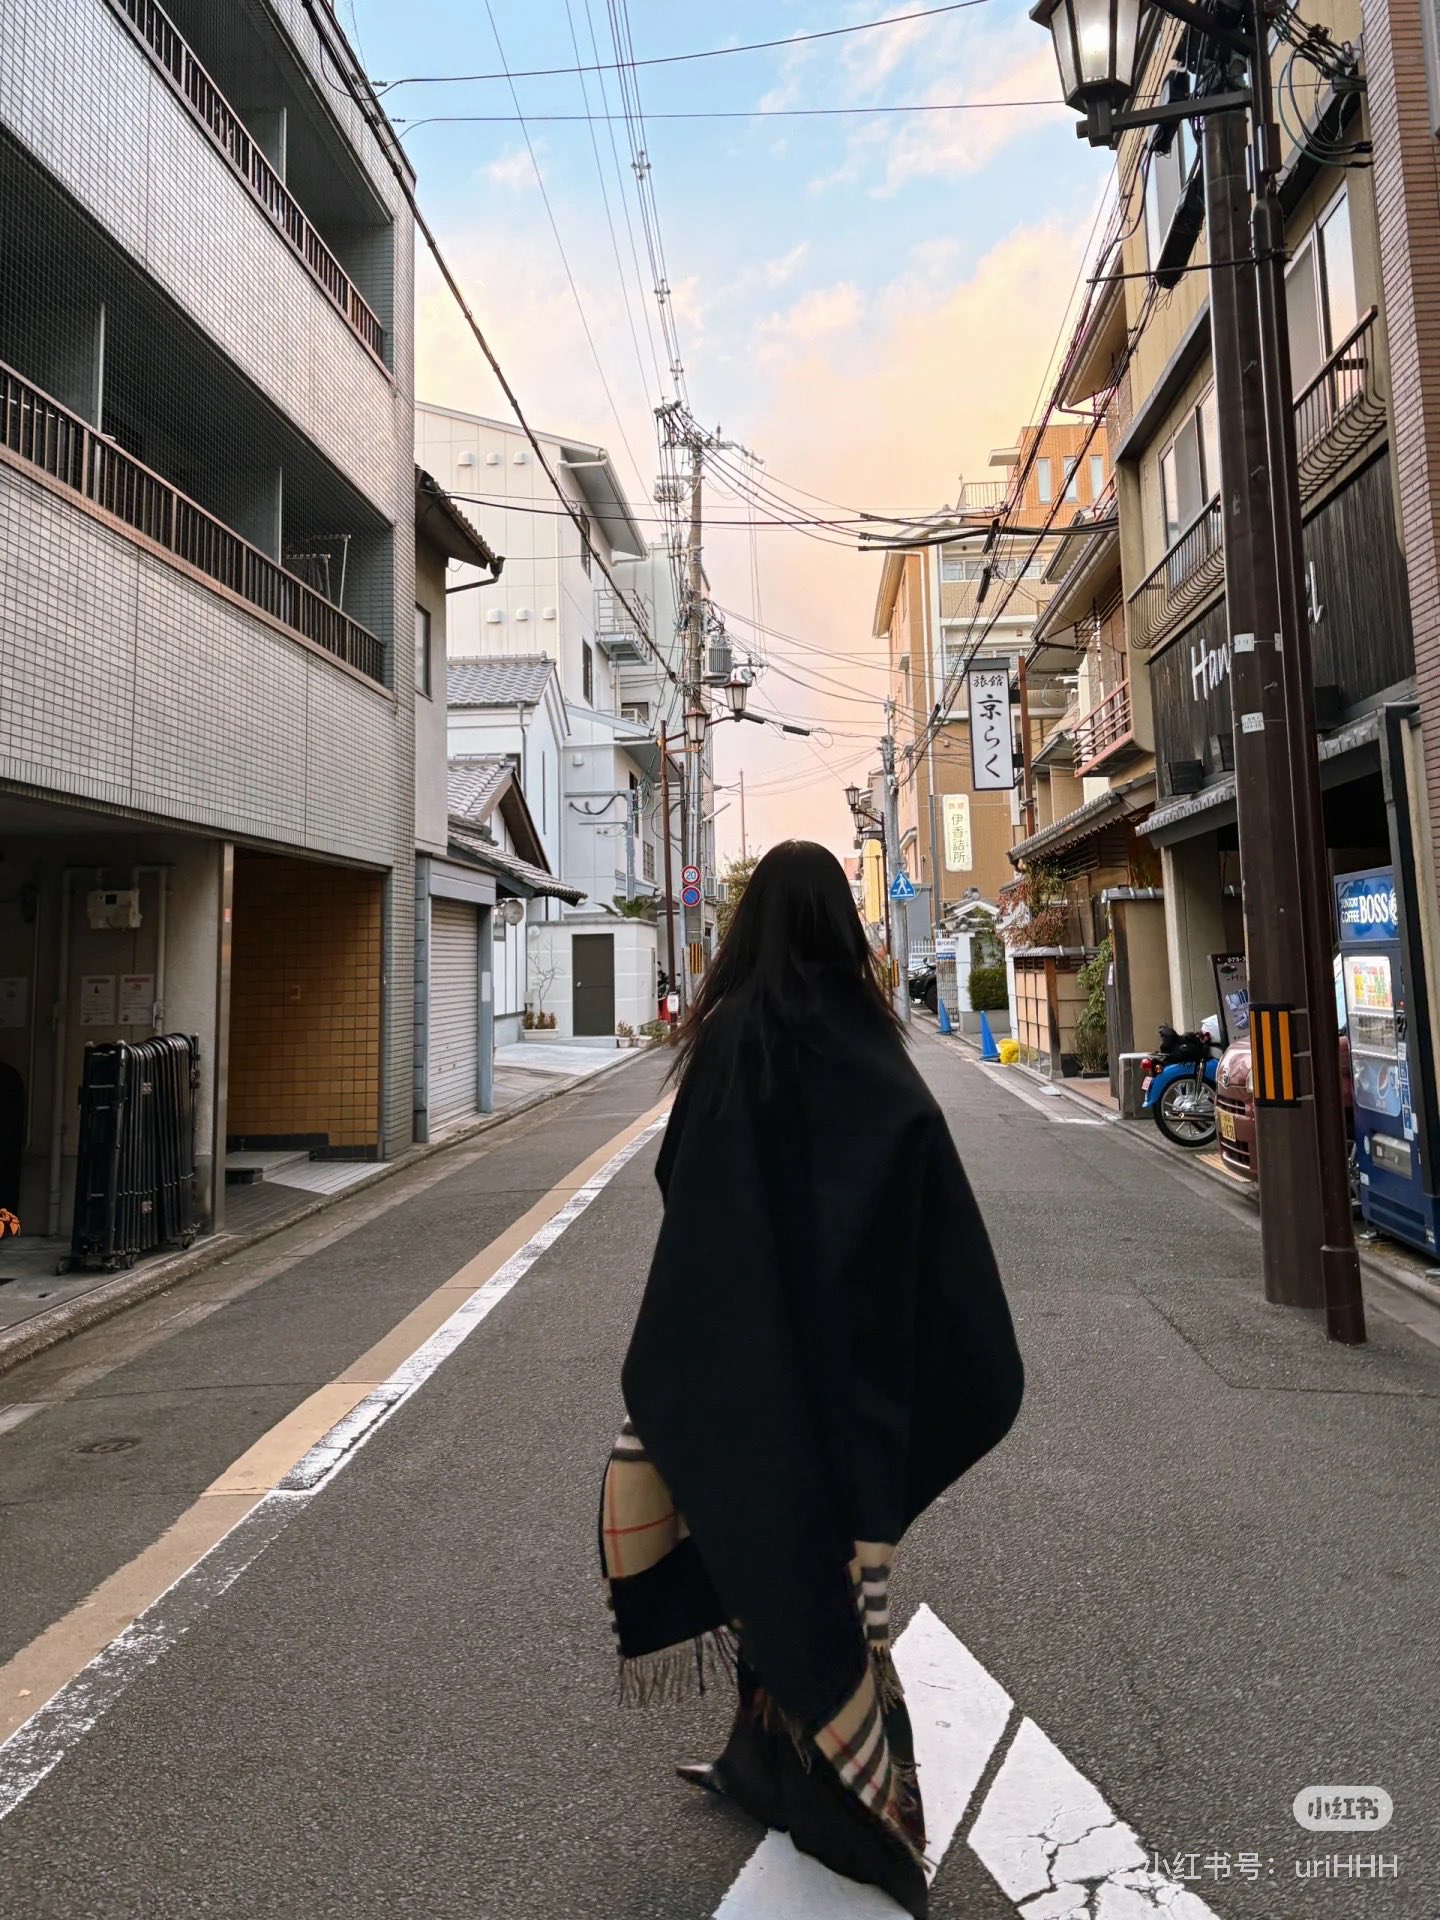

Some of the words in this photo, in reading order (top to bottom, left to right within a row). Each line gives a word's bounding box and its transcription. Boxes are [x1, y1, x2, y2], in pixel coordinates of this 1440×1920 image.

[973, 675, 1004, 688] 旅館
[976, 694, 1003, 779] 京らく
[686, 870, 697, 880] 20
[1359, 892, 1389, 924] BOSS
[1341, 910, 1359, 923] COFFEE
